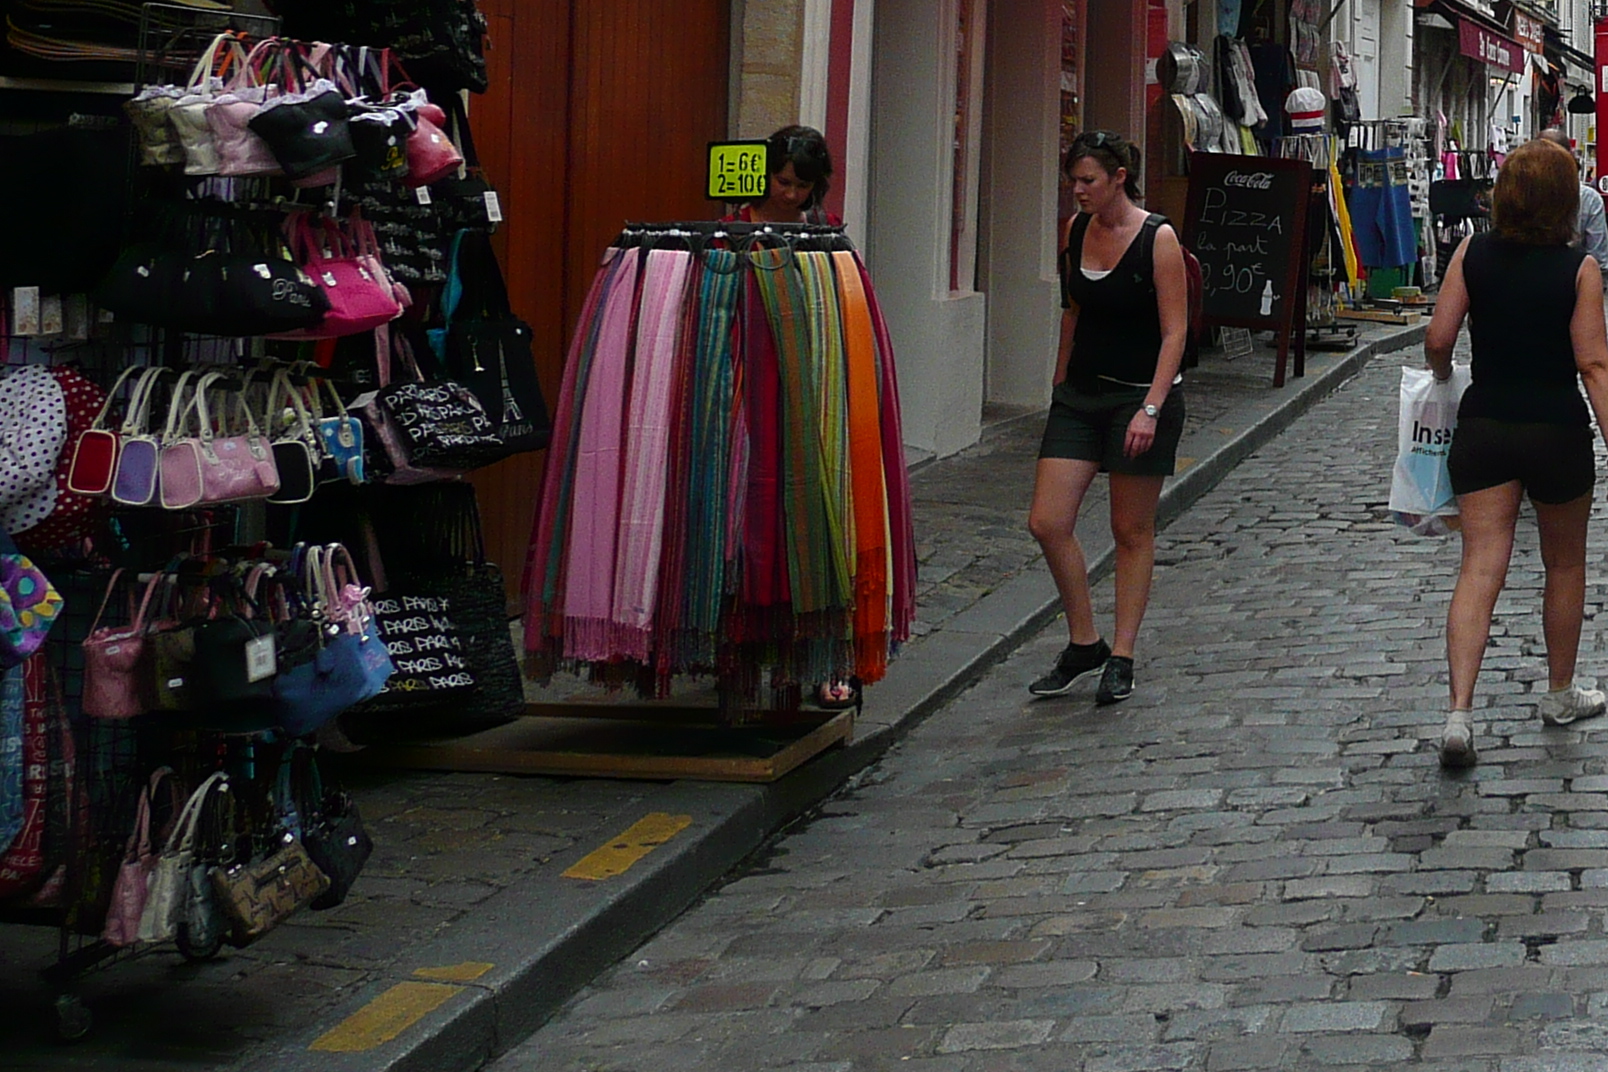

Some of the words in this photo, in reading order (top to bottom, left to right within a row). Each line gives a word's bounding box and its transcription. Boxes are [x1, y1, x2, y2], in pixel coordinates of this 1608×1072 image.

[1199, 187, 1282, 235] PIZZA
[1197, 230, 1217, 251] la
[1223, 235, 1268, 261] part
